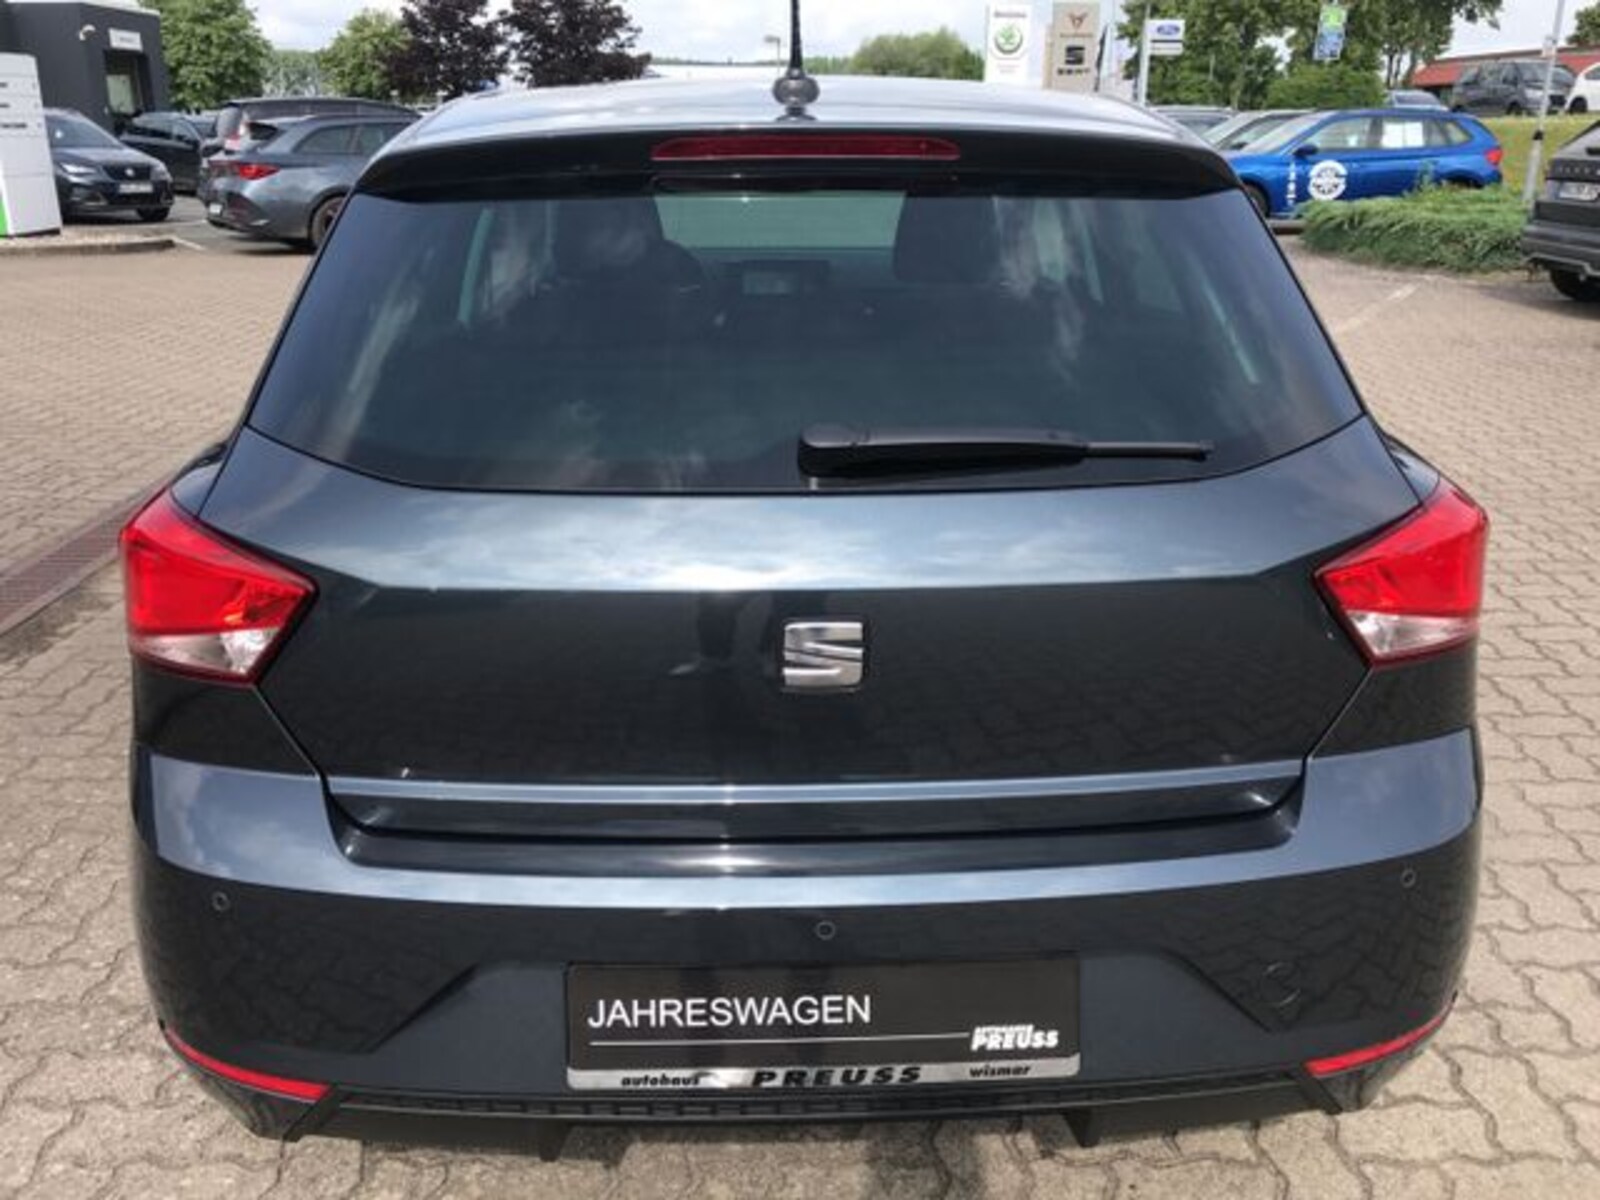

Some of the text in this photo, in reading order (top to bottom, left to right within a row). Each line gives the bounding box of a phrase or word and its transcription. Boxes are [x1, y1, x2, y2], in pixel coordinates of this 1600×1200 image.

[587, 994, 871, 1029] JAHRESWAGEN
[970, 1024, 1059, 1051] PREUSS
[621, 1065, 1031, 1088] autohaus PREUSS wismar
